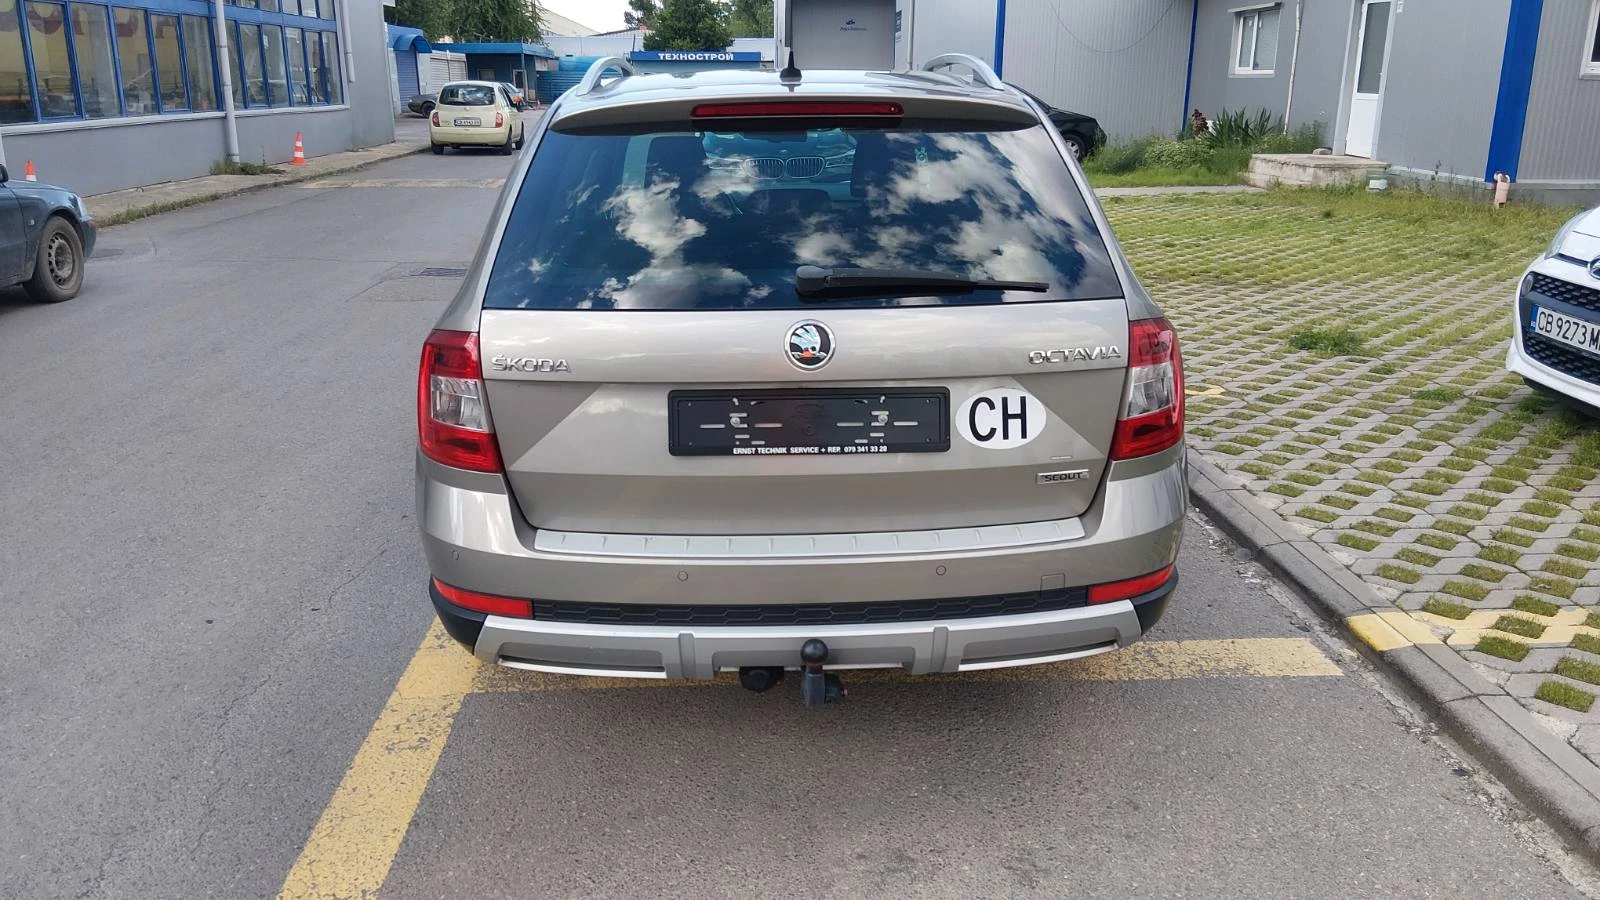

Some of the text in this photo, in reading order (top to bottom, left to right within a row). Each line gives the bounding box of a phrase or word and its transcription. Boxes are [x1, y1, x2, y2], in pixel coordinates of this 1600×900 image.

[658, 52, 734, 61] ТЕХНОСТРОЙ
[1538, 311, 1600, 351] CB 9273 M
[491, 354, 571, 373] ŠKODA
[1028, 345, 1121, 365] OCTAVIA
[968, 395, 1027, 442] CH
[733, 447, 756, 455] ERNST
[757, 447, 788, 455] TECHNIK
[790, 446, 820, 454] SERVICE
[1044, 471, 1083, 482] SCOUT
